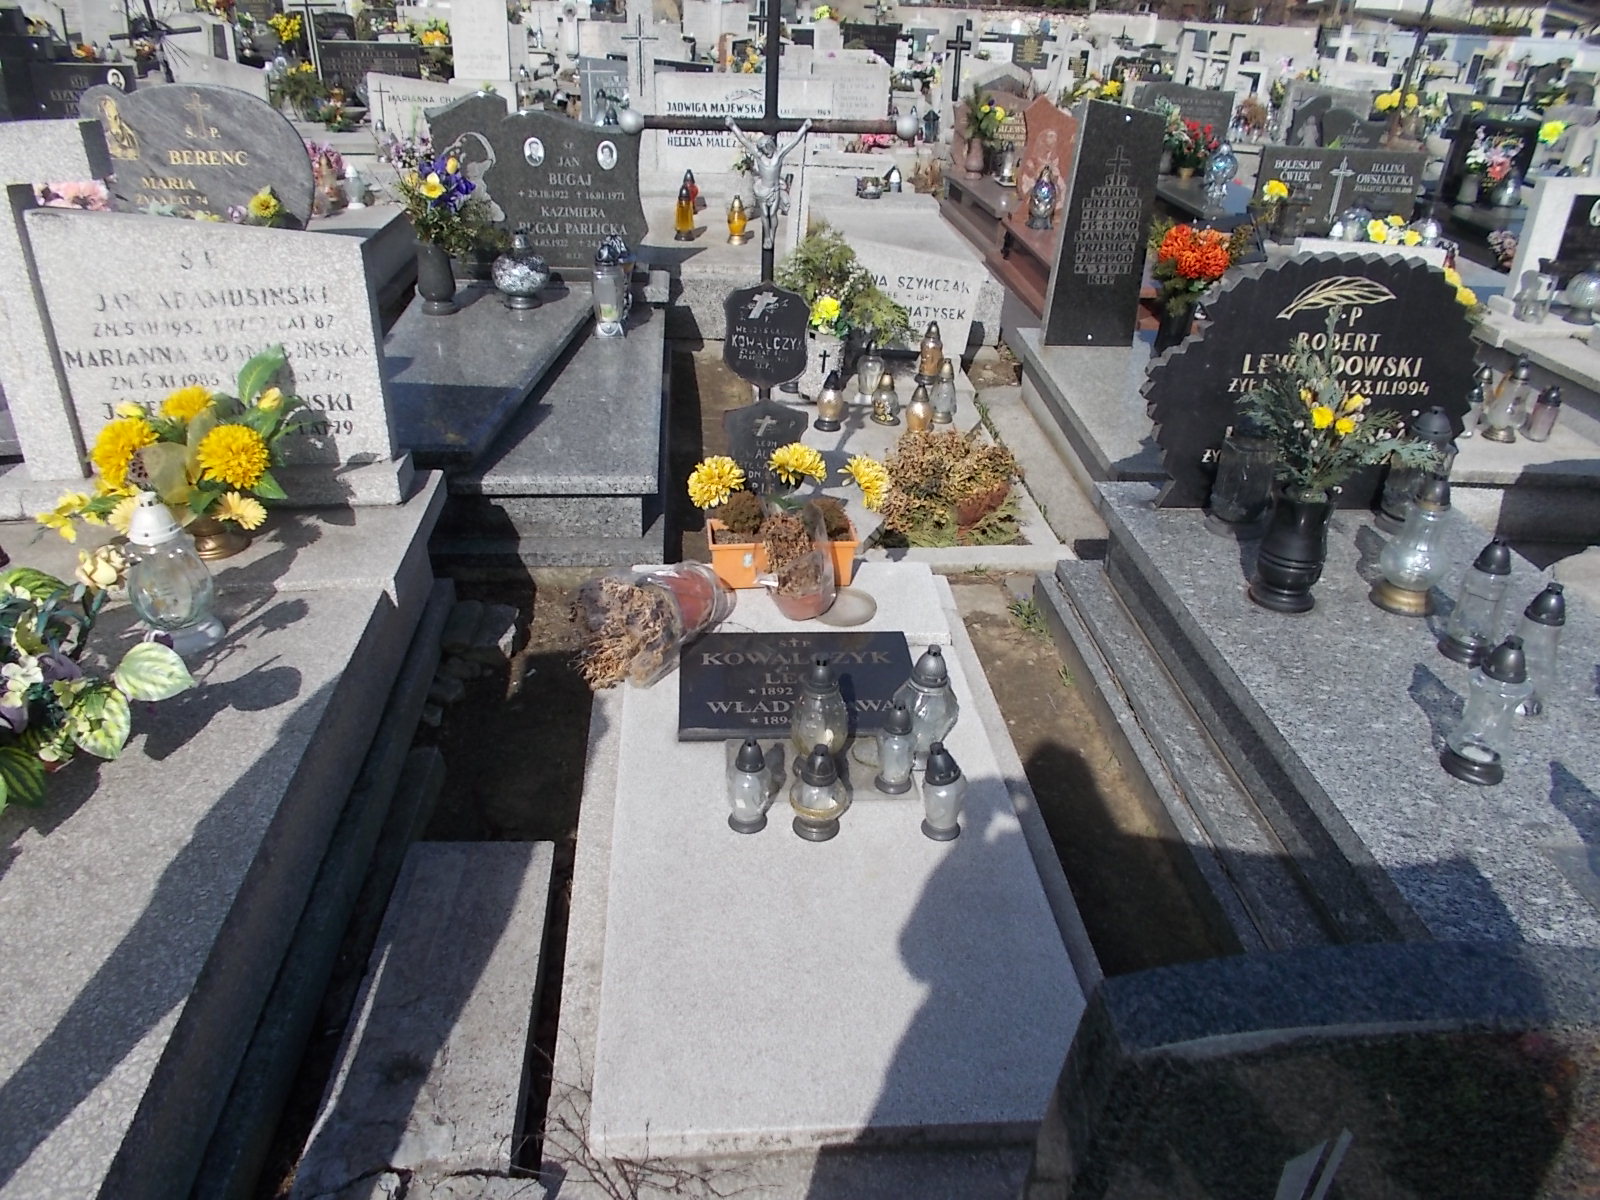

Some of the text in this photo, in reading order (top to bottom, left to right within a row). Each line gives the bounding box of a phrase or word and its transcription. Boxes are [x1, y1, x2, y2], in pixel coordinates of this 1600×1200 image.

[666, 101, 764, 114] JADWIGA MAJEWSKA
[667, 137, 702, 147] HELENA
[167, 150, 249, 166] BERENC
[557, 157, 581, 168] JAN
[1371, 162, 1406, 174] HALINA
[140, 176, 196, 191] MARIA
[548, 172, 592, 187] BUGAJ
[540, 206, 606, 218] KAZIMIERA
[565, 223, 628, 235] PARLICKA
[897, 276, 971, 294] SZYMCZAK
[1297, 331, 1382, 352] ROBERT
[64, 344, 189, 369] MARIANNA
[1241, 353, 1424, 378] LEWDOWSKI
[760, 687, 794, 696] 1892
